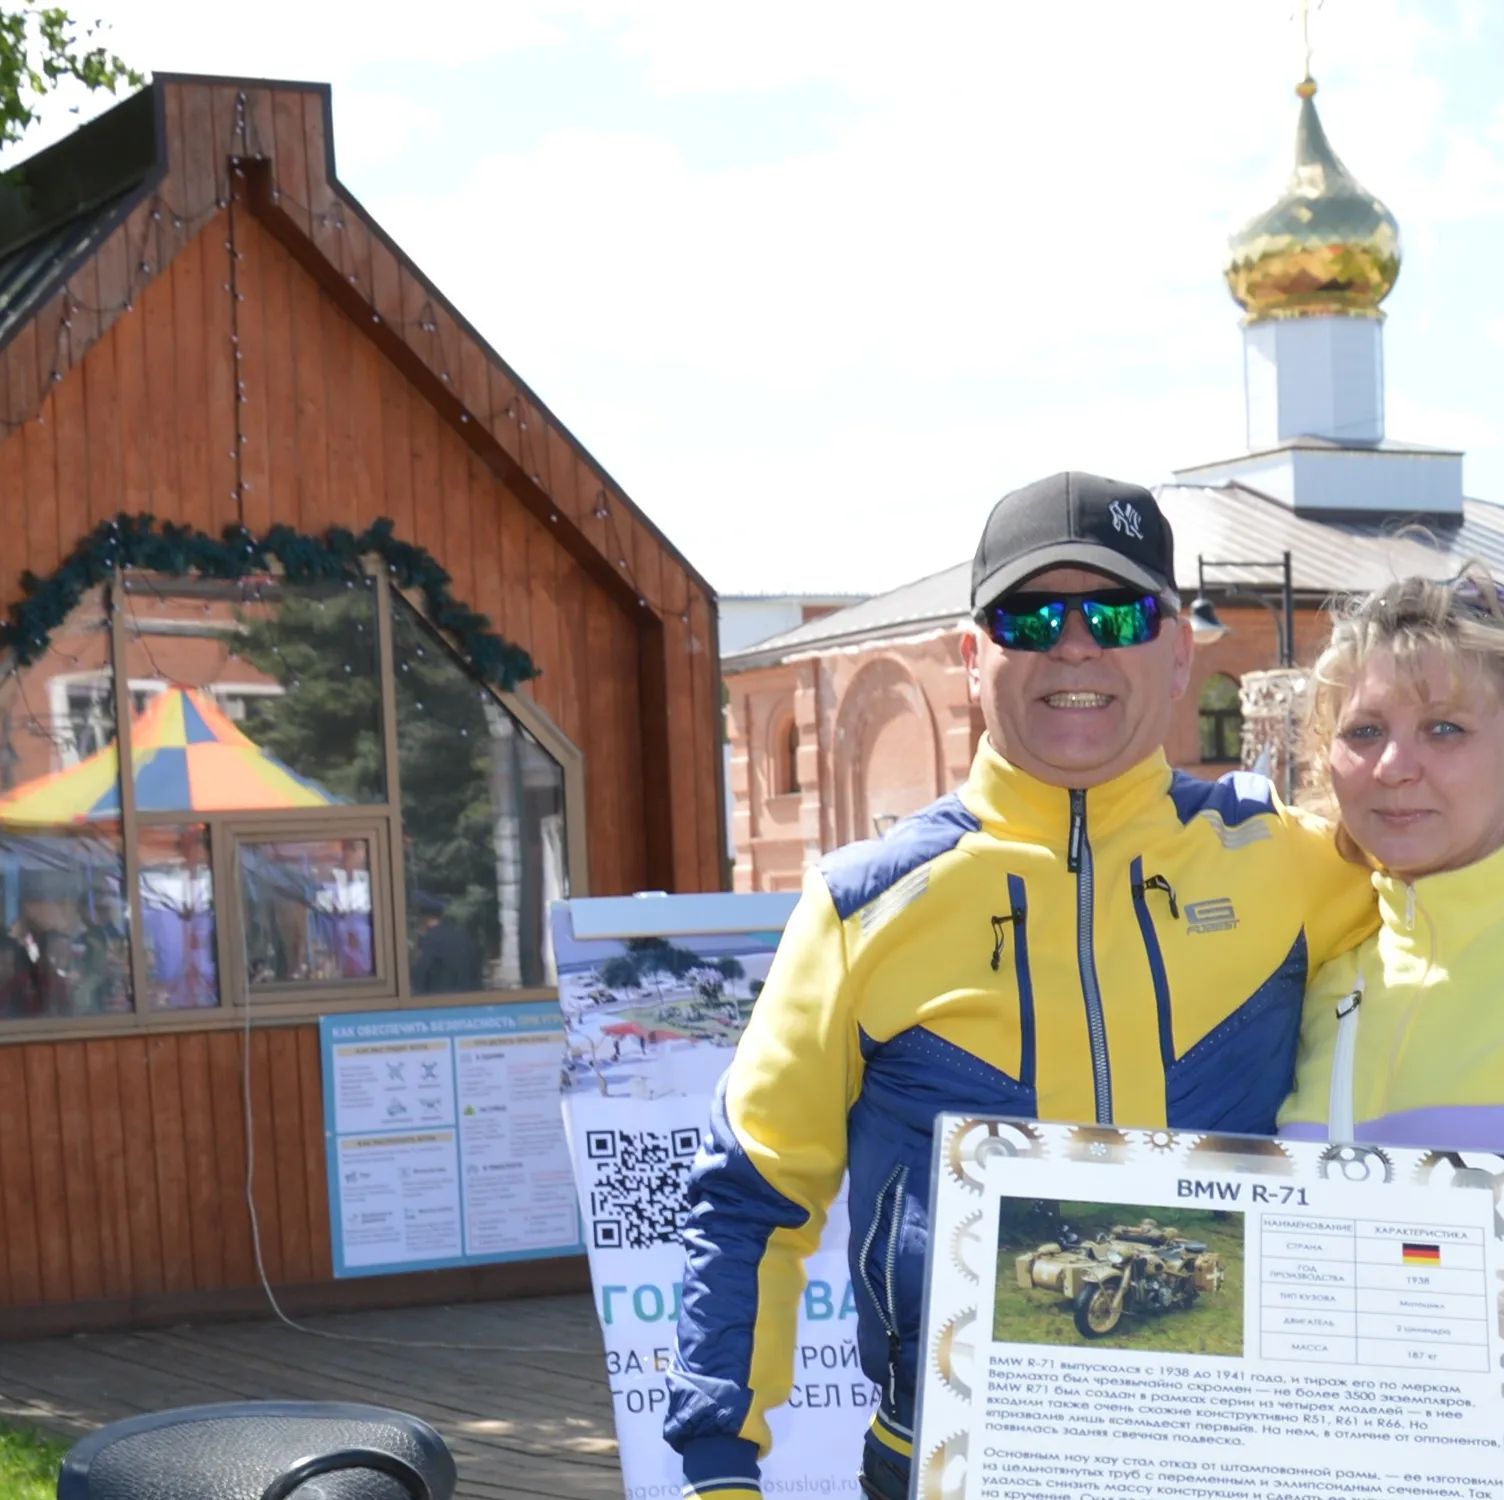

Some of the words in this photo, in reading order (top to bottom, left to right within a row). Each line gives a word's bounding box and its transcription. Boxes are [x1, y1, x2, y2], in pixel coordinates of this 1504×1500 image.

[1177, 1178, 1241, 1201] BMW
[1252, 1184, 1309, 1206] R-71
[1264, 1220, 1352, 1232] НАИМЕНОВАНИЕ
[1375, 1227, 1467, 1239] ХАРАКТЕРИСТИКА
[1286, 1242, 1322, 1251] СТРАНА
[1270, 1271, 1343, 1282] ПРОИЗВОДСТВА
[1297, 1264, 1317, 1272] ГОД
[1406, 1276, 1429, 1284] 1938
[1280, 1292, 1297, 1300] ТИП
[1299, 1293, 1335, 1302] КУЗОВА
[1283, 1317, 1334, 1327] ДВИГАТЕЛЬ
[1291, 1343, 1327, 1351] МАССА
[1407, 1351, 1425, 1360] 187
[607, 1349, 644, 1375] ЗА
[988, 1368, 1058, 1385] Вермахта
[1093, 1375, 1183, 1391] чрезвычайно
[1186, 1382, 1251, 1396] скромен
[1295, 1387, 1340, 1399] более
[1344, 1389, 1376, 1401] 3500
[1380, 1393, 1475, 1409] экземпляров.
[1027, 1357, 1054, 1368] R-71
[1060, 1361, 1140, 1375] выпускался
[1160, 1366, 1189, 1377] 1938
[1216, 1369, 1244, 1380] 1941
[1250, 1373, 1286, 1384] года,
[1303, 1376, 1347, 1388] тираж
[1400, 1383, 1461, 1396] меркам
[788, 1383, 841, 1408] СЕЛ
[1084, 1388, 1136, 1400] создан
[1150, 1392, 1207, 1405] рамках
[1209, 1396, 1254, 1409] серии
[1277, 1400, 1334, 1413] четырех
[1338, 1402, 1403, 1419] моделей
[986, 1396, 1043, 1407] входили
[1048, 1400, 1089, 1410] также
[1093, 1402, 1134, 1412] очень
[1138, 1405, 1191, 1416] схожие
[1196, 1408, 1298, 1425] конструктивно
[985, 1409, 1064, 1423] «призвали»
[1108, 1416, 1190, 1429] «семьдесят
[1195, 1420, 1258, 1435] первый».
[1334, 1430, 1390, 1441] отличие
[1413, 1434, 1500, 1448] оппонентов,
[985, 1422, 1058, 1434] появилась
[1062, 1427, 1108, 1437] задняя
[1112, 1430, 1168, 1441] свечная
[1172, 1433, 1244, 1446] подвеска.
[983, 1446, 1060, 1461] Основным
[1158, 1459, 1197, 1469] отказ
[1220, 1461, 1330, 1477] штампованной
[1335, 1469, 1380, 1482] рамы,
[1426, 1474, 1503, 1487] изготовили
[764, 1475, 858, 1496] osuslugi.ru
[982, 1475, 1042, 1488] удалось
[1045, 1479, 1100, 1490] снизить
[1104, 1483, 1152, 1495] массу
[1156, 1486, 1248, 1500] конструкции
[1001, 1463, 1104, 1479] цельнотянутых
[1157, 1472, 1256, 1488] переменным
[1273, 1479, 1382, 1493] эллипсоидным
[1386, 1485, 1464, 1498] сечением.
